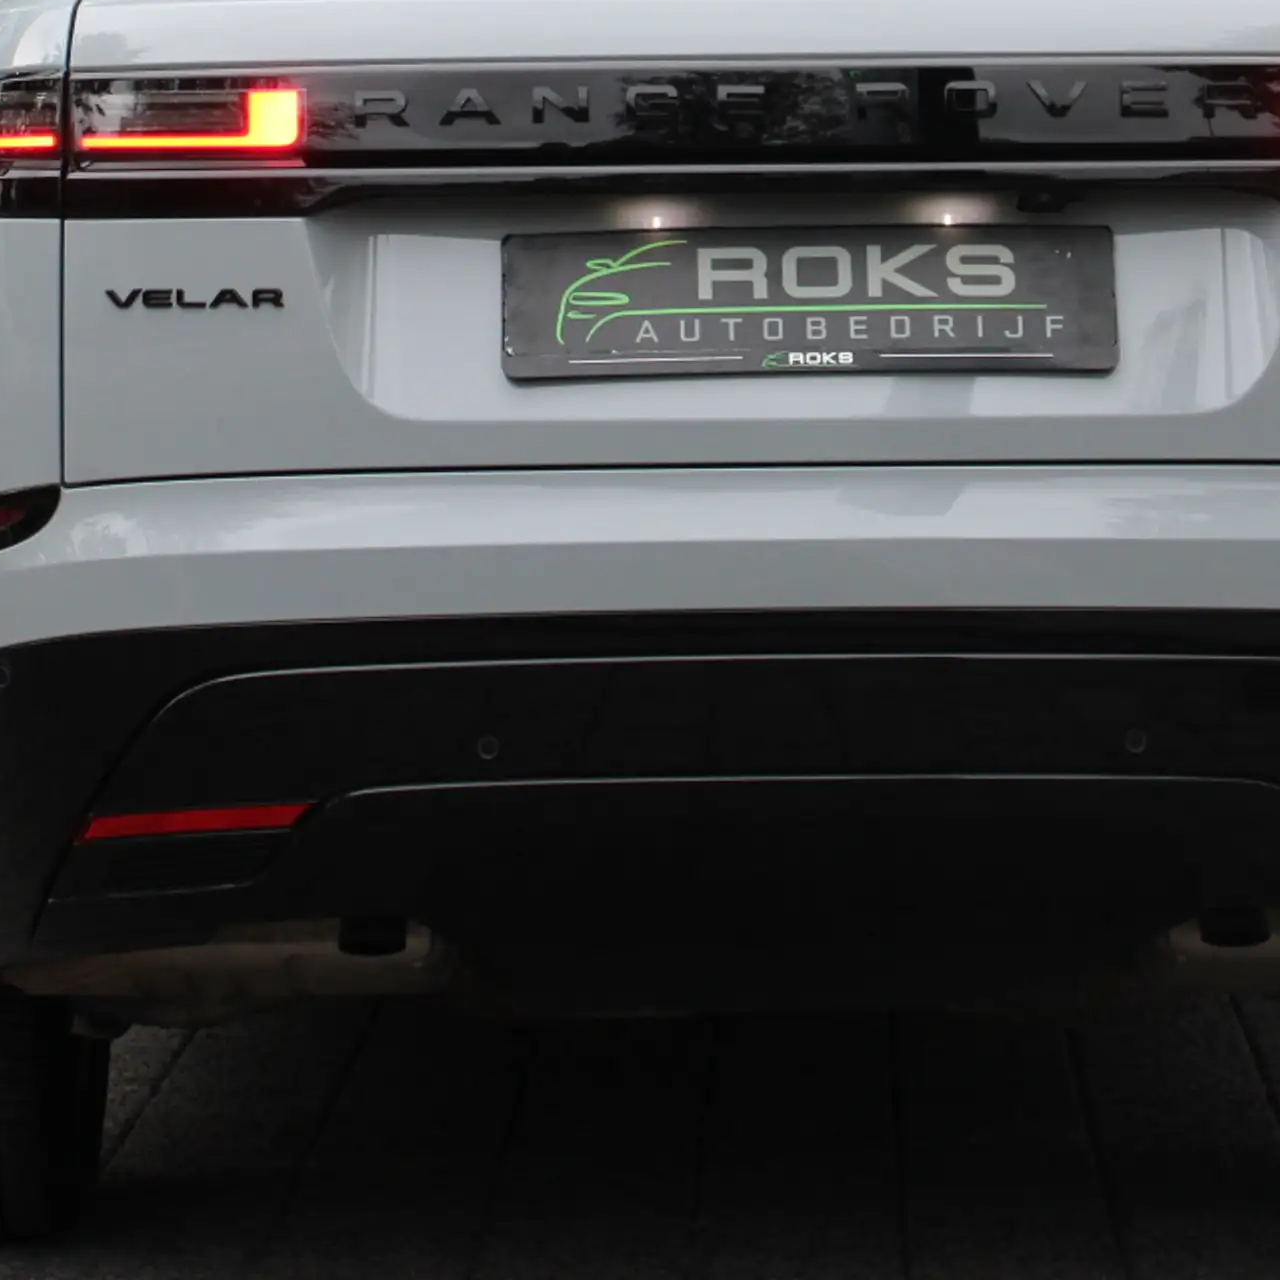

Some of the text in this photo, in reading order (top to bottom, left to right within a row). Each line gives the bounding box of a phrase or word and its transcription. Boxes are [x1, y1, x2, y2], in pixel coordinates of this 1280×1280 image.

[352, 85, 768, 129] RANGE
[696, 243, 1018, 300] ROKS
[105, 288, 285, 311] VELAR
[635, 315, 1064, 344] AUTOBEDRIJF
[788, 351, 854, 365] ROKS
